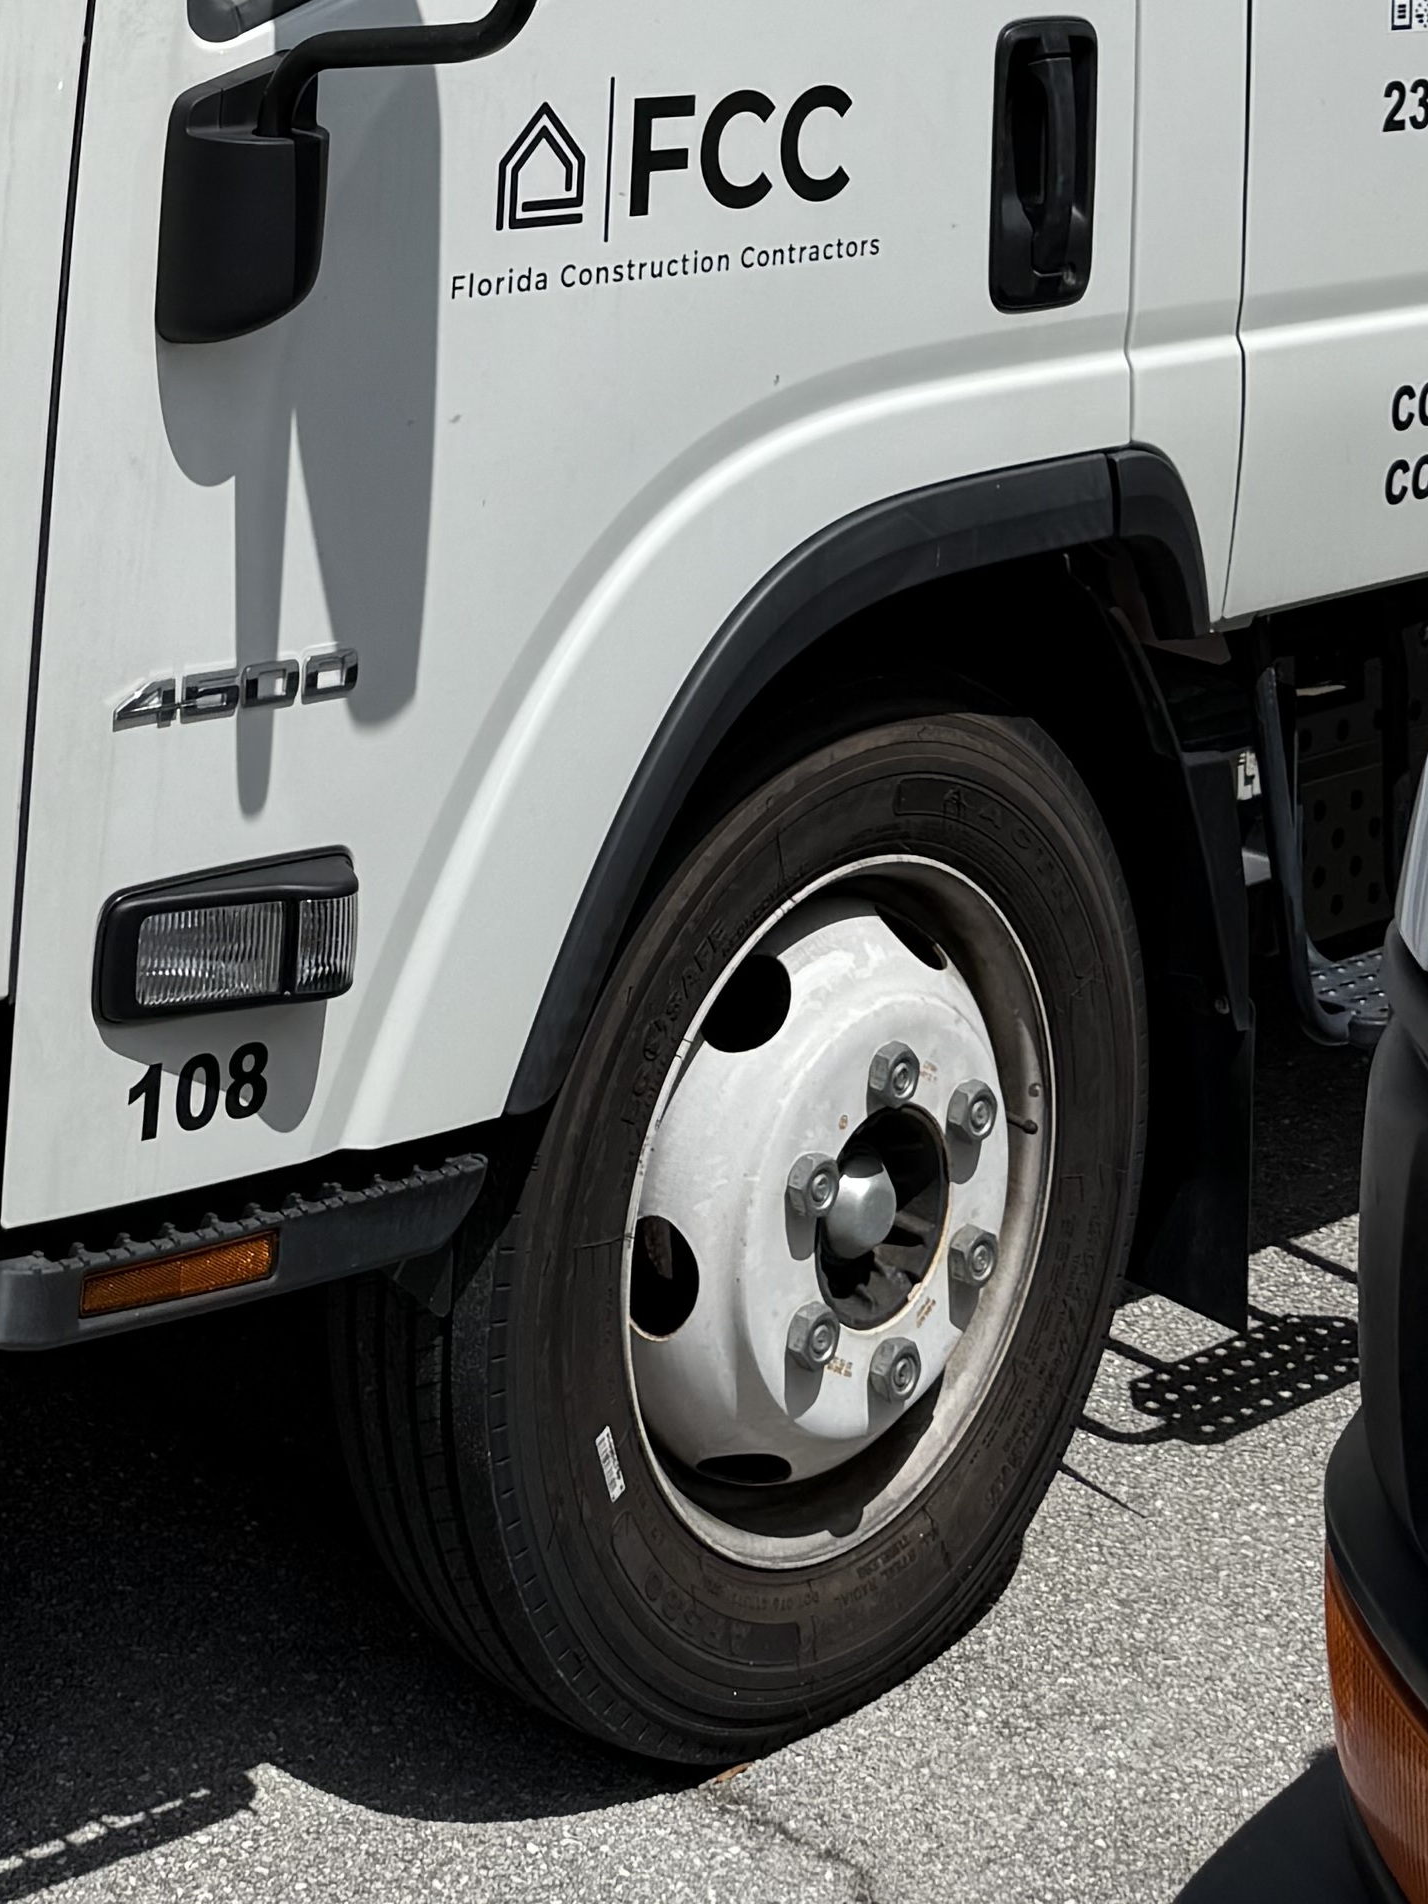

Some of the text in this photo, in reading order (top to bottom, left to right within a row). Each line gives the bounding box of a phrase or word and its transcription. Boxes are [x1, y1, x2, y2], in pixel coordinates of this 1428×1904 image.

[629, 83, 853, 218] FCC
[450, 236, 881, 300] Florida Construction Contractors
[112, 647, 359, 732] 4500
[127, 1041, 269, 1141] 108
